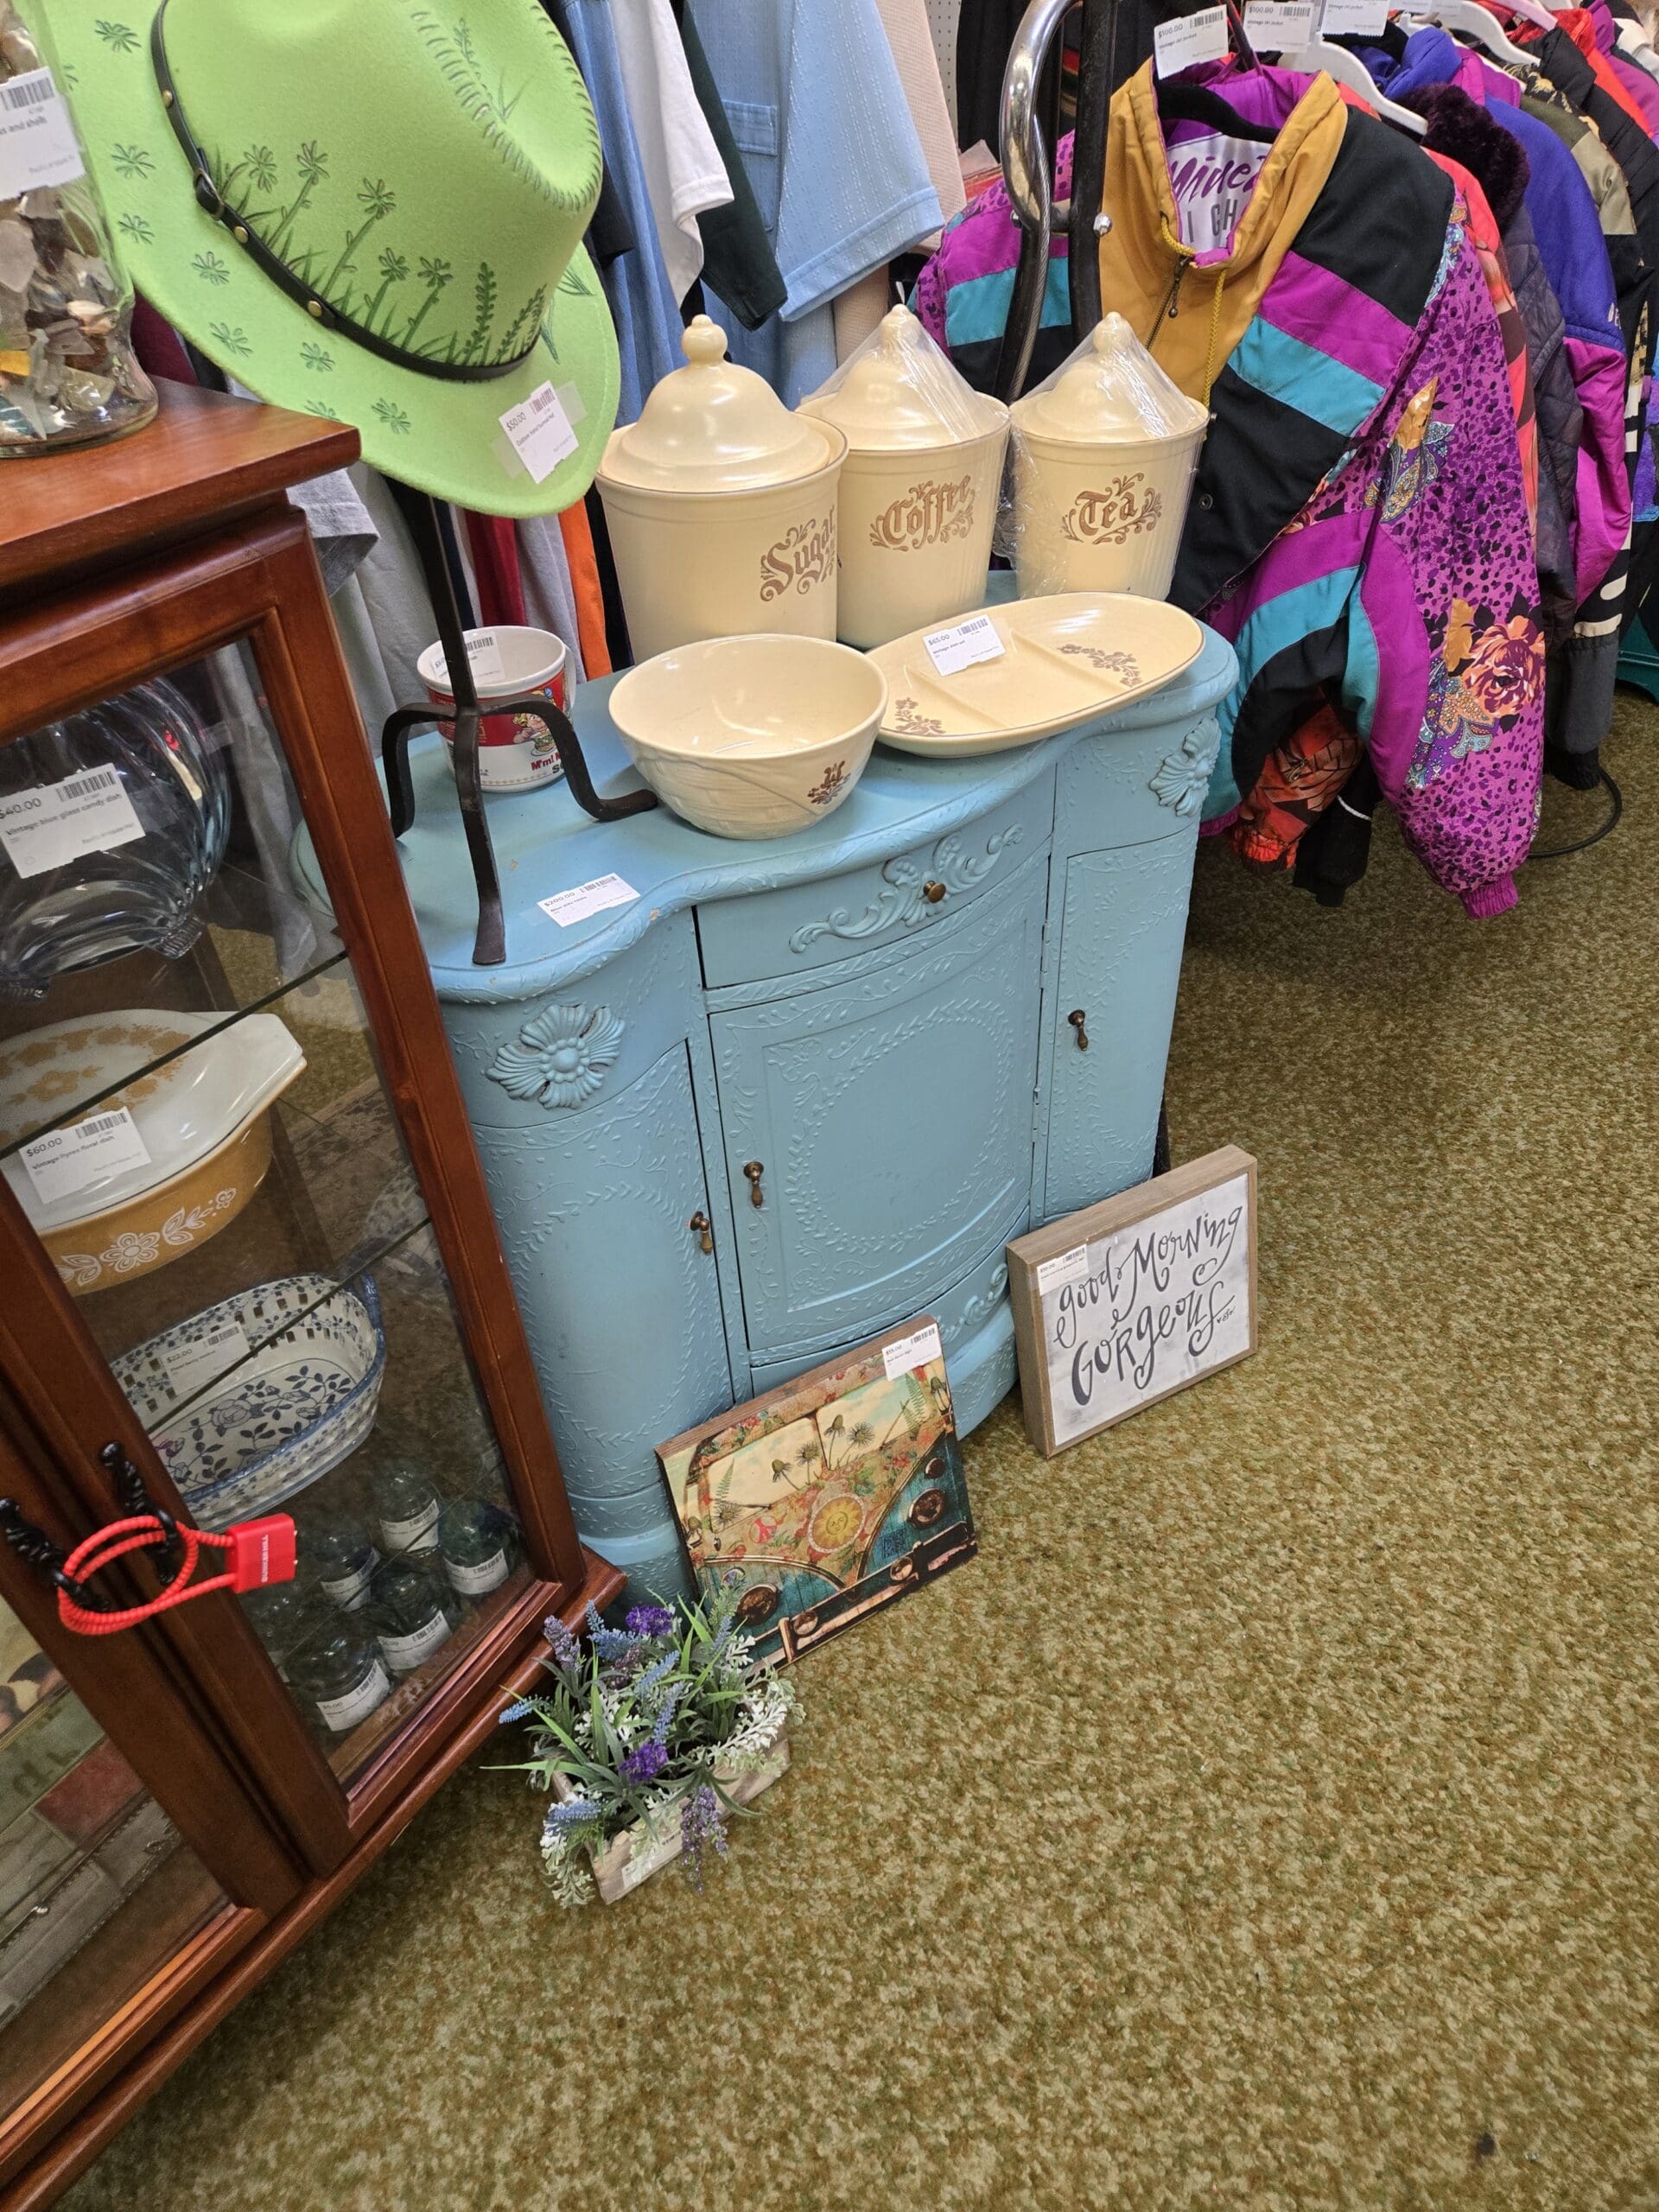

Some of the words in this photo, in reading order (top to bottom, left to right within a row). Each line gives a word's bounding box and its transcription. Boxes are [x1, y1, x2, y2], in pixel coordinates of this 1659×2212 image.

[1158, 23, 1183, 39] $100.00
[506, 411, 526, 432] $50.00
[877, 475, 971, 550] Coffee
[1075, 490, 1138, 536] Tea
[760, 504, 835, 601] Sugar
[928, 634, 950, 646] $65.00
[0, 798, 42, 820] $40.00
[544, 892, 576, 907] $200.00
[26, 1137, 63, 1158] $60.00
[167, 1348, 193, 1363] $22.00
